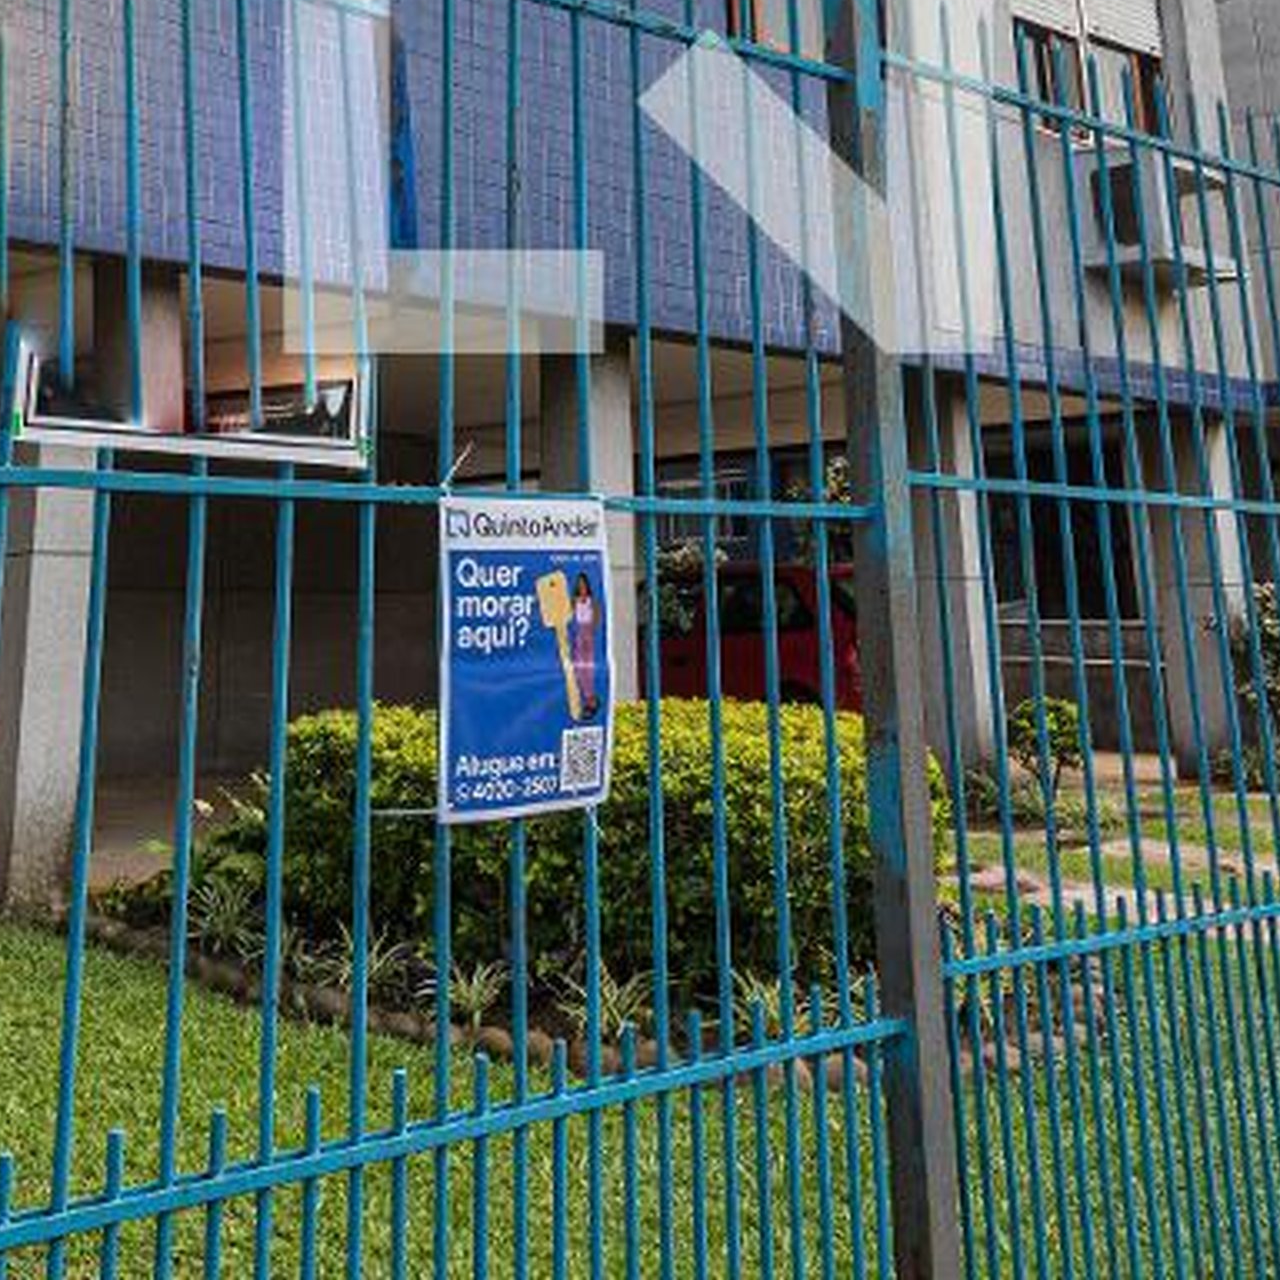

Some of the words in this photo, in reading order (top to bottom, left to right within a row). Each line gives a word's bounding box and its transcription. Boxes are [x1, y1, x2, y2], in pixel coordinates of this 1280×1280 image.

[473, 512, 600, 538] QuintoAndar
[456, 558, 523, 588] Quer
[456, 594, 535, 617] morar
[455, 754, 524, 781] Alugue
